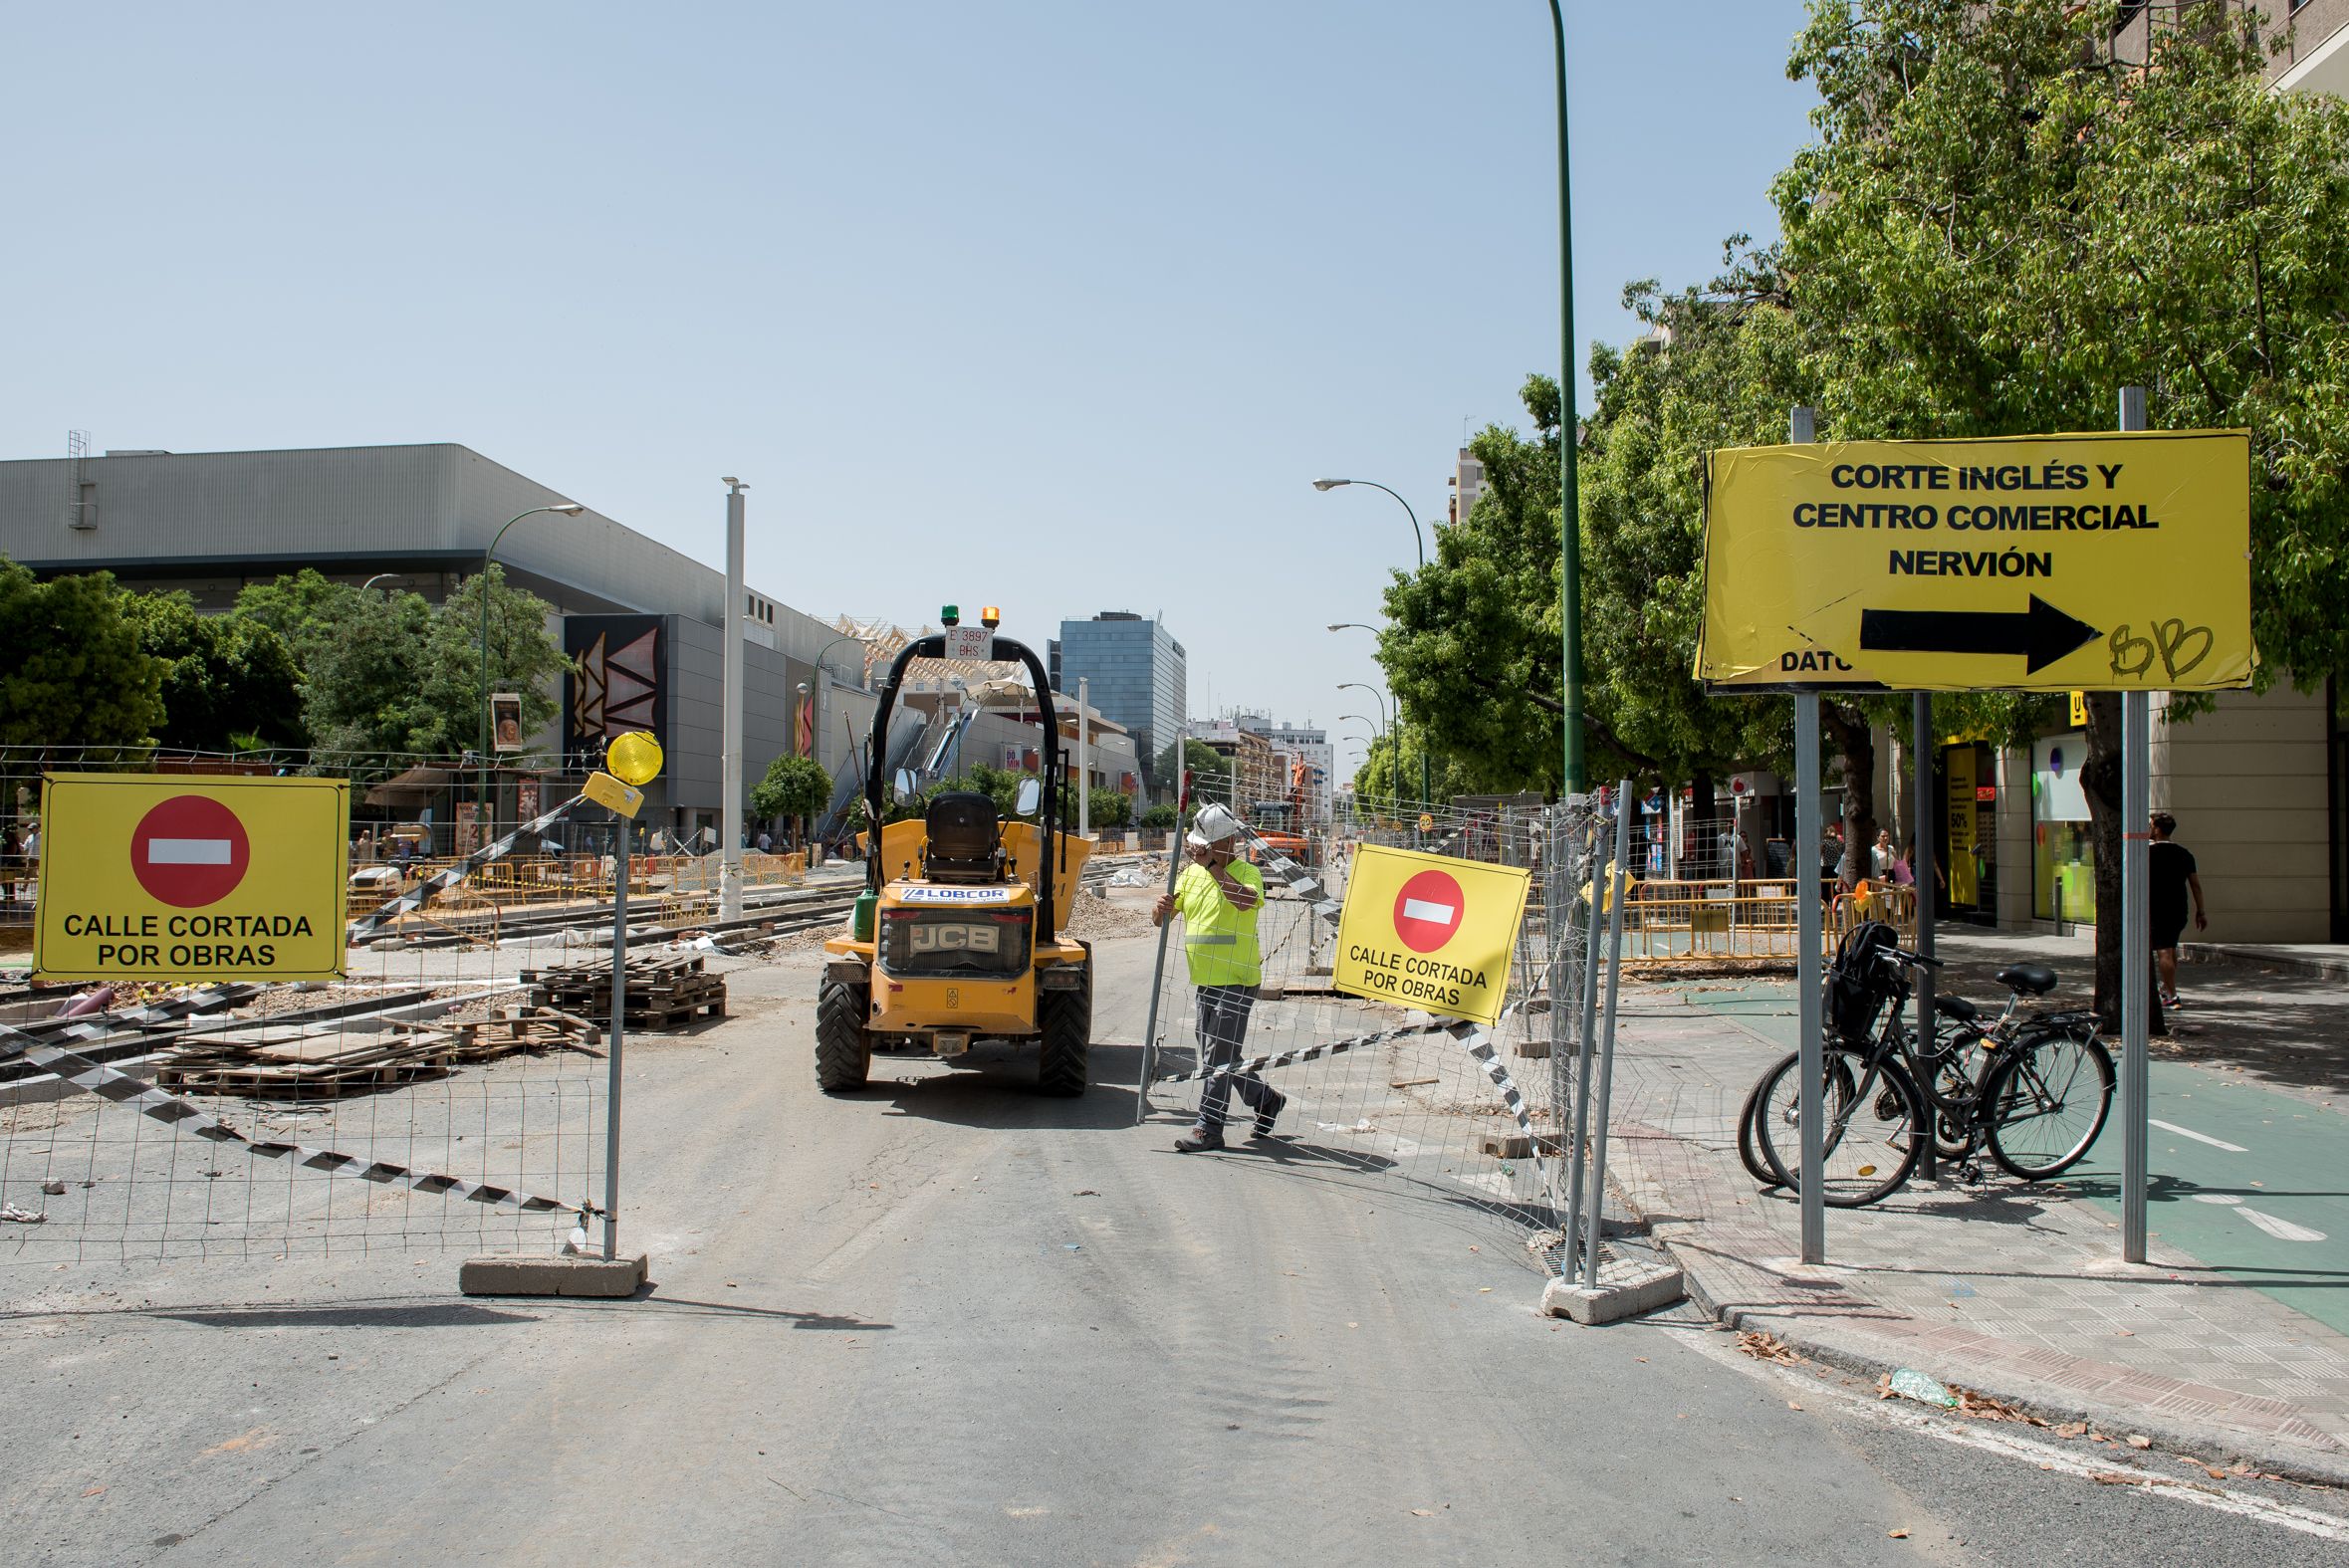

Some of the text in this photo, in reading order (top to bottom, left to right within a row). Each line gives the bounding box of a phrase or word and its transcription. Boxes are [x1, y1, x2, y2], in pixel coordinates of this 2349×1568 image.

[1831, 459, 2123, 491] CORTE INGLÉS Y
[1792, 503, 2159, 531] CENTRO COMERCIAL
[1889, 547, 2052, 577] NERVIÓN
[950, 629, 988, 642] E 3897
[959, 645, 979, 656] BHS
[1952, 812, 1968, 828] 50%
[927, 889, 1005, 899] LOBCOR
[64, 915, 313, 938] CALLE CORTADA
[913, 925, 997, 951] JCB
[98, 944, 276, 966] POR OBRAS
[1350, 945, 1488, 989] CALLE CORTADA
[1364, 970, 1461, 1006] POR OBRAS
